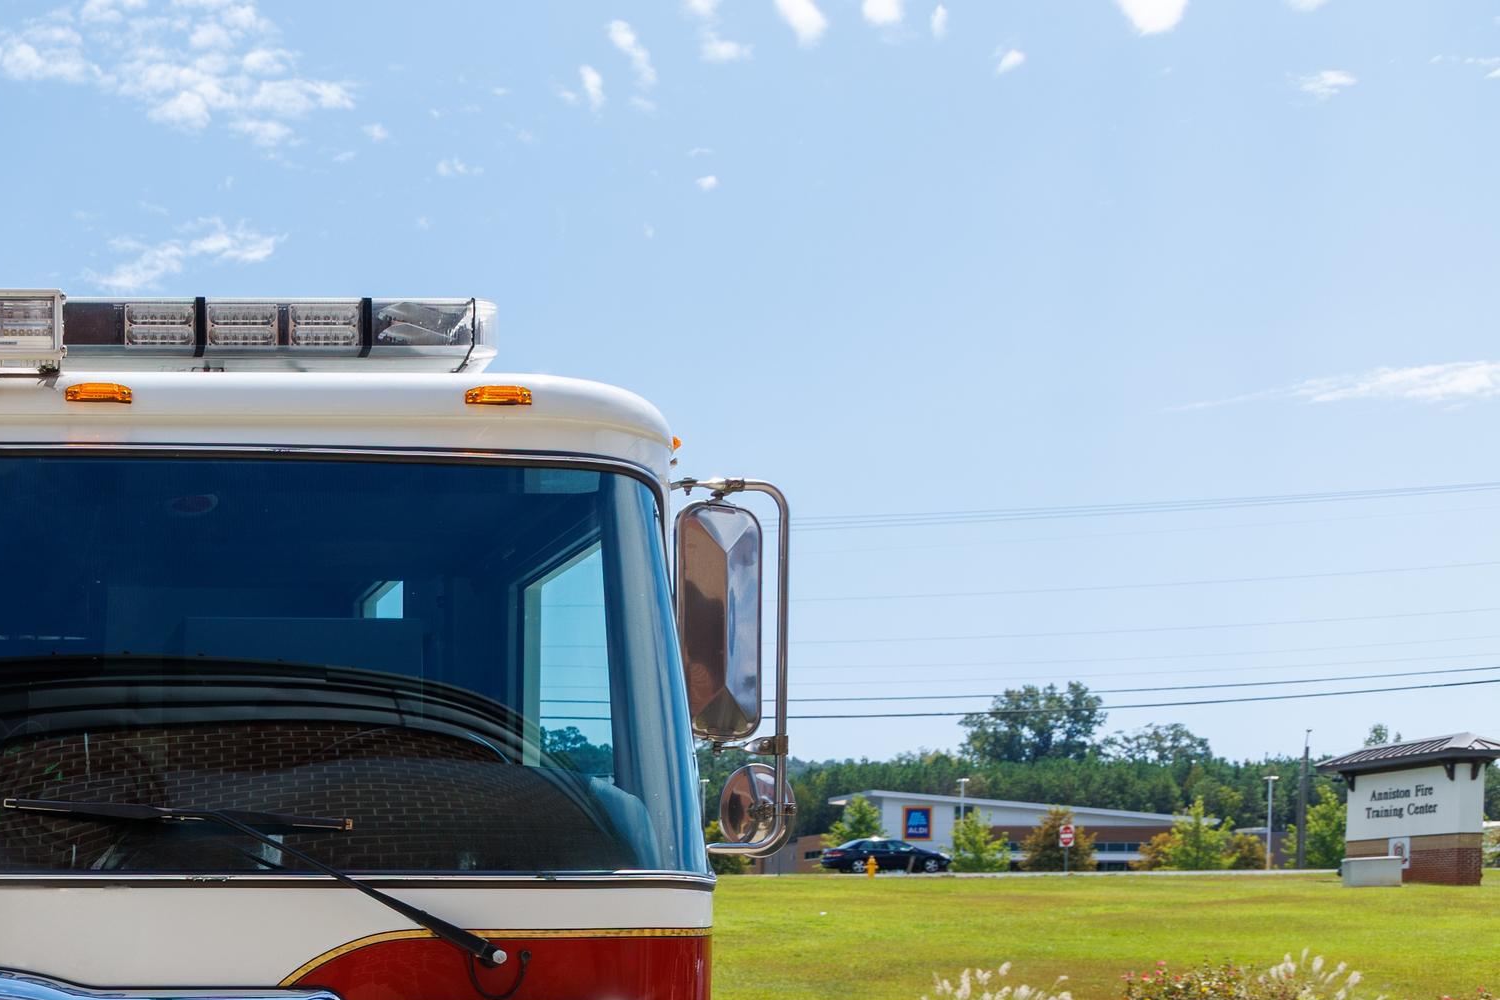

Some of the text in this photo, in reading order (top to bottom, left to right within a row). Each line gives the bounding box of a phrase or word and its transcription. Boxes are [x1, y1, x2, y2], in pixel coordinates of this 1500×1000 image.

[1370, 784, 1433, 801] Anniston Fire
[1365, 803, 1438, 819] Training Center
